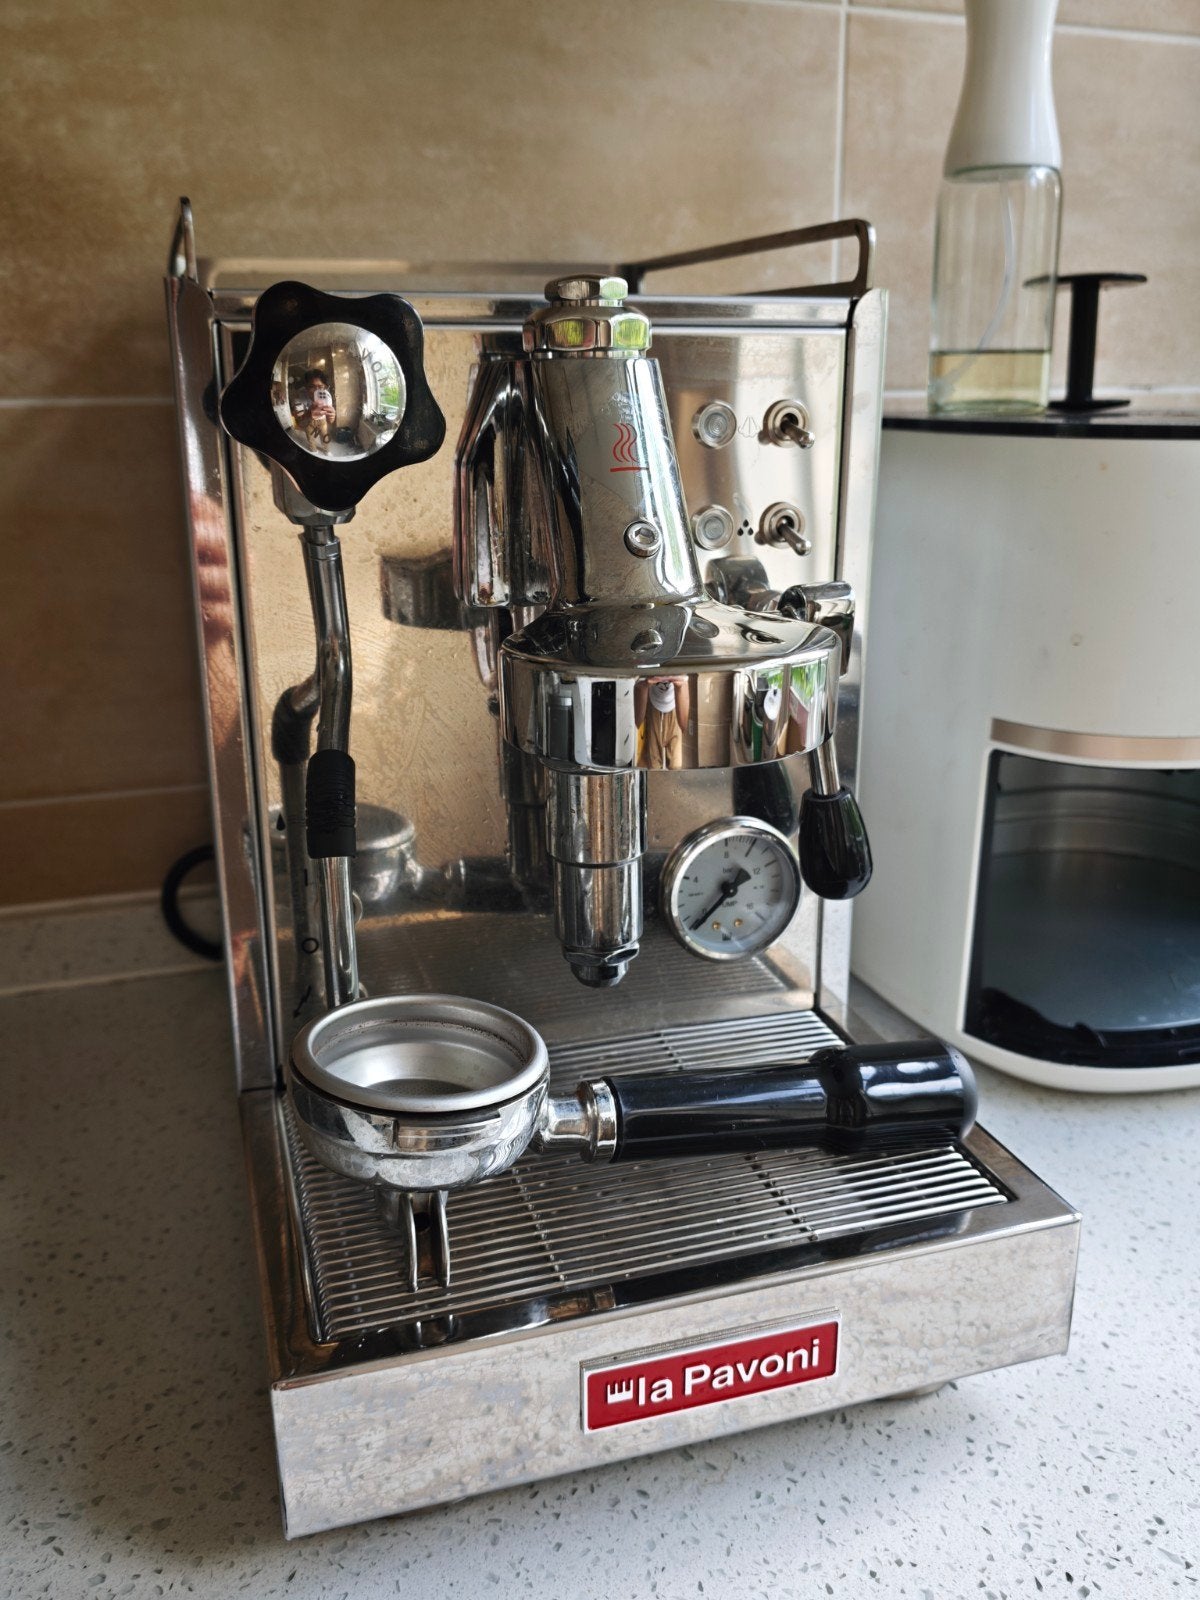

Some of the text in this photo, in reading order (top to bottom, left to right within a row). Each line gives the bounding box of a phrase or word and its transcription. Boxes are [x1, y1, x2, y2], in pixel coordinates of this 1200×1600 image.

[753, 867, 761, 875] 12
[638, 1338, 820, 1406] la Pavoni
